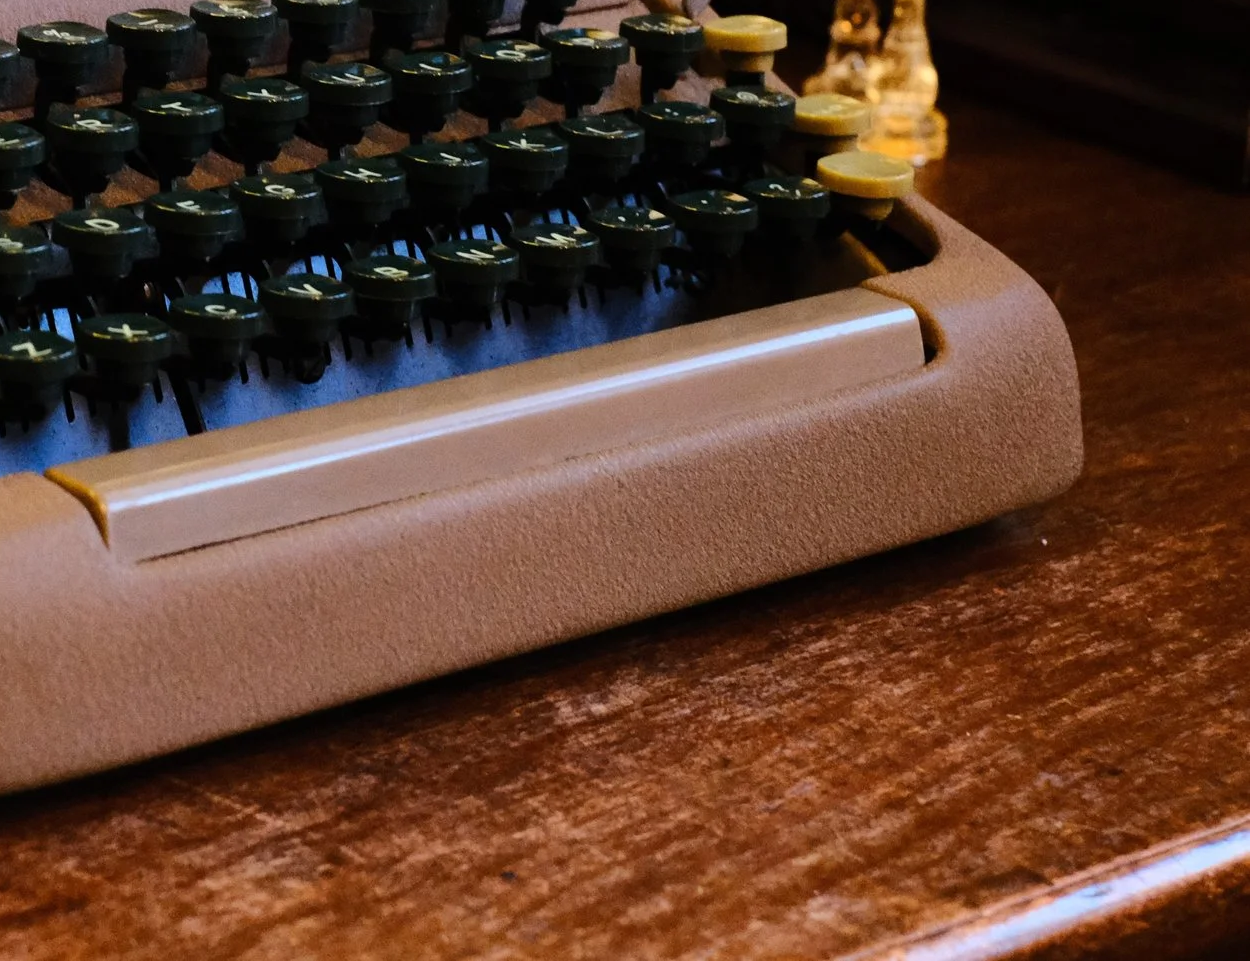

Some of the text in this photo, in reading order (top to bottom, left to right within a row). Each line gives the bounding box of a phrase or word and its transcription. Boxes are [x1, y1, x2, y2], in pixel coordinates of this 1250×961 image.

[160, 101, 192, 112] T
[76, 118, 114, 131] R
[342, 167, 383, 180] H
[84, 218, 120, 231] D
[372, 265, 410, 279] B
